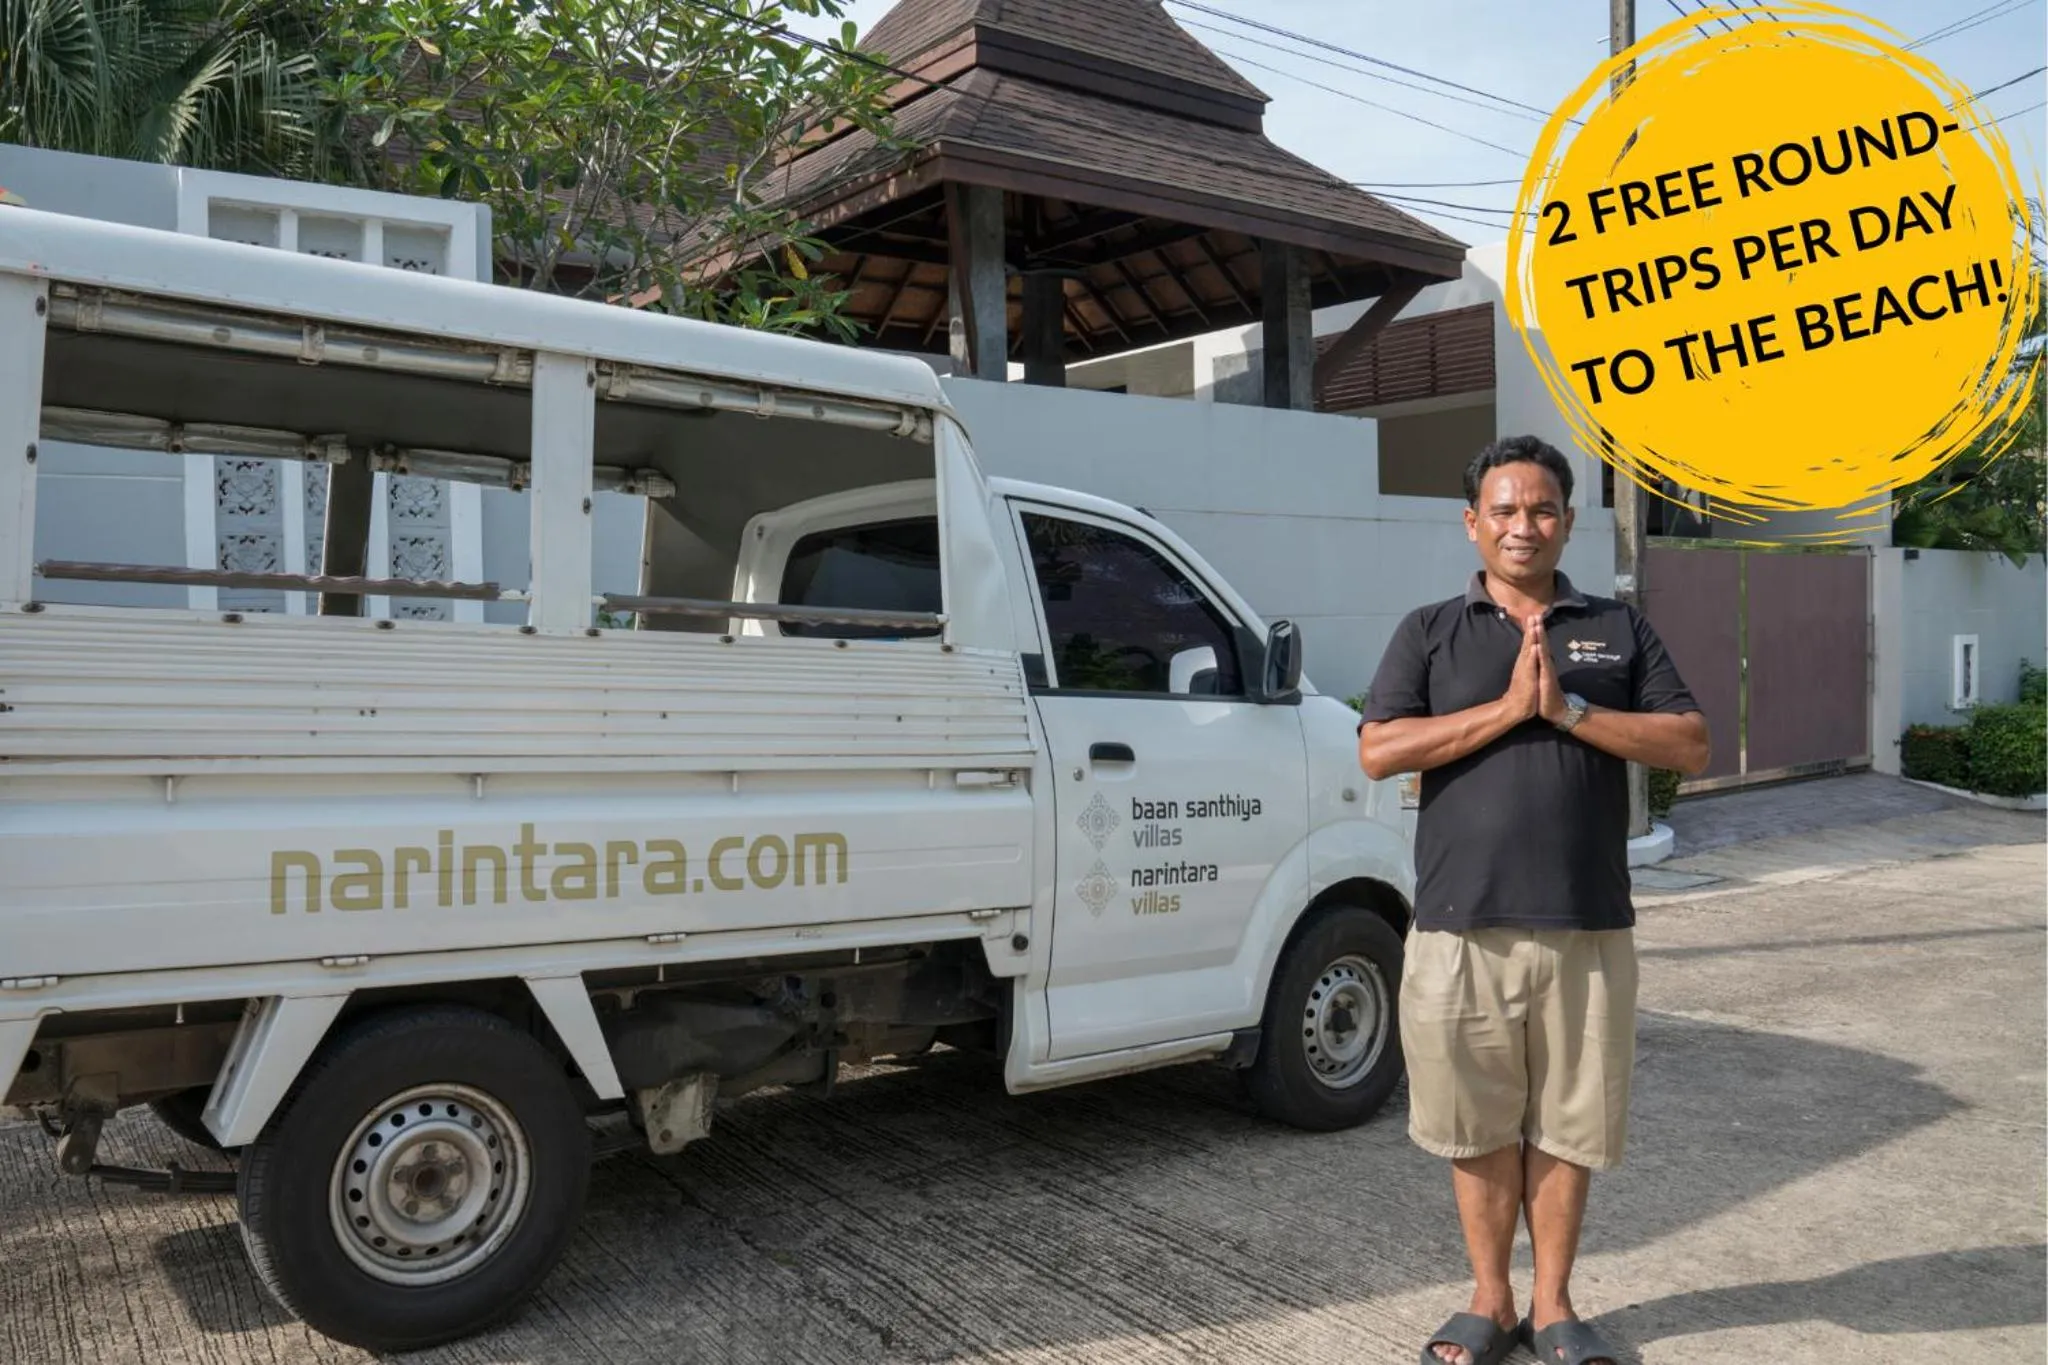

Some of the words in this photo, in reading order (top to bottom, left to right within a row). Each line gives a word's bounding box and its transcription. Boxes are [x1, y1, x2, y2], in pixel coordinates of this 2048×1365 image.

[1132, 797, 1178, 820] baan
[1186, 793, 1261, 821] santhiya
[1133, 824, 1182, 848] villas
[270, 823, 848, 914] narintara.com
[1131, 861, 1218, 887] narintara
[1132, 892, 1181, 915] villas
